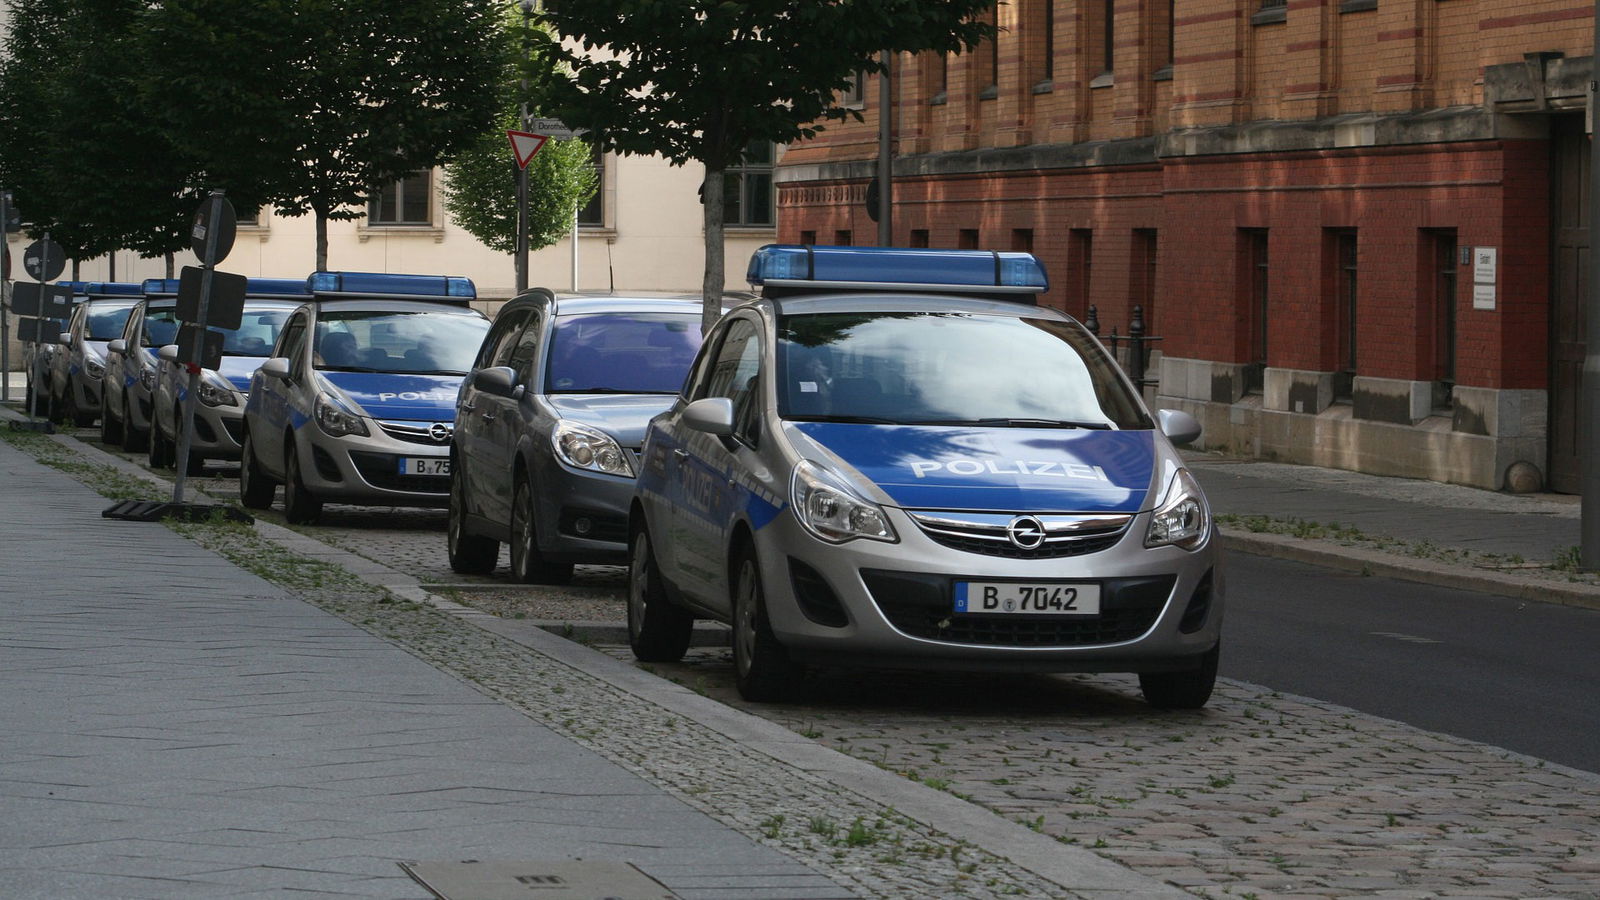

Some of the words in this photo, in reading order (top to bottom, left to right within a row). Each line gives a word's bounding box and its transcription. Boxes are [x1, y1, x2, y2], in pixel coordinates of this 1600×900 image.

[379, 391, 457, 402] POLIZ
[417, 460, 426, 473] B
[434, 461, 451, 473] 75
[909, 460, 1108, 481] POLIZEI
[983, 586, 998, 610] B
[1019, 587, 1077, 611] 7042
